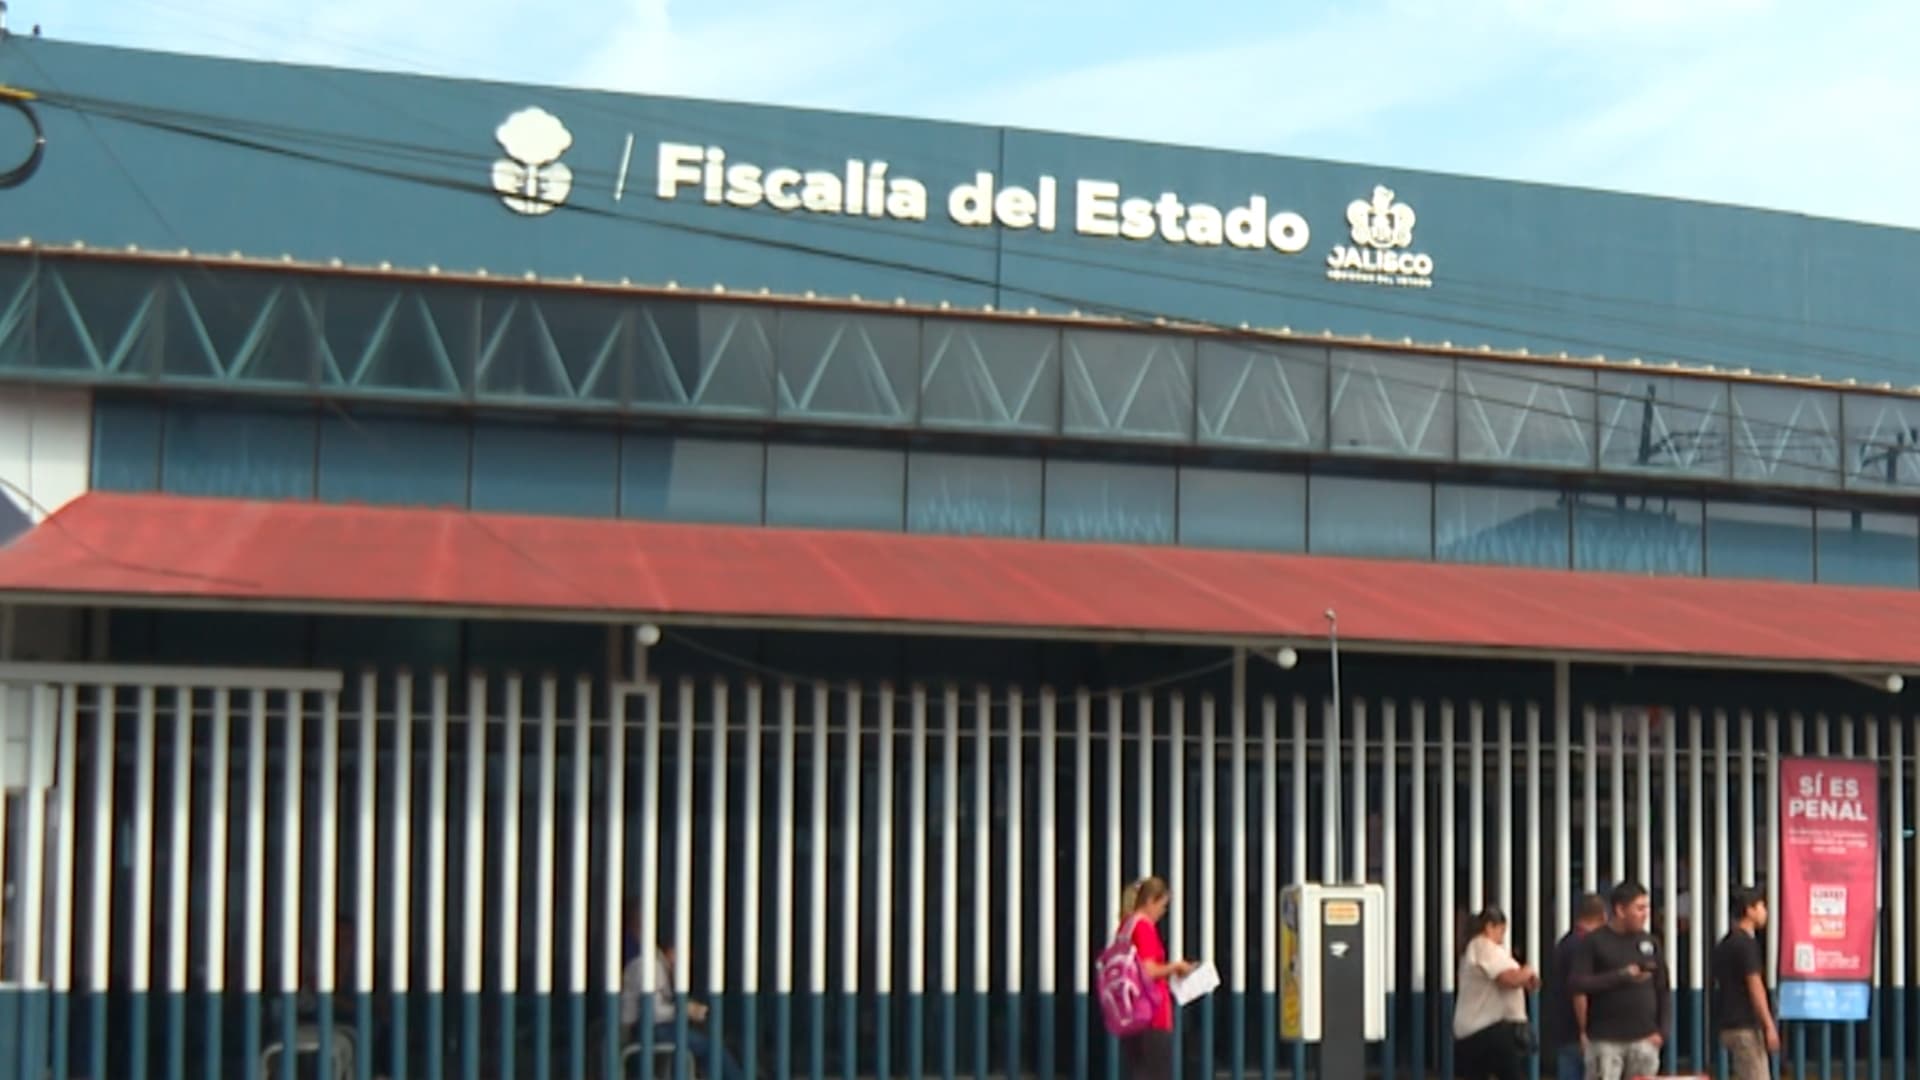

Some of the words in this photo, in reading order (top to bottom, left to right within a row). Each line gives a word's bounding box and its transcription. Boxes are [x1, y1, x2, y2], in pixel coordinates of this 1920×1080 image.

[656, 140, 927, 220] Fiscalía
[948, 170, 1057, 231] del
[1074, 178, 1311, 252] Estado
[1326, 245, 1433, 276] JALISCO
[1799, 770, 1823, 797] SÍ
[1830, 776, 1859, 799] ES
[1789, 798, 1868, 822] PENAL
